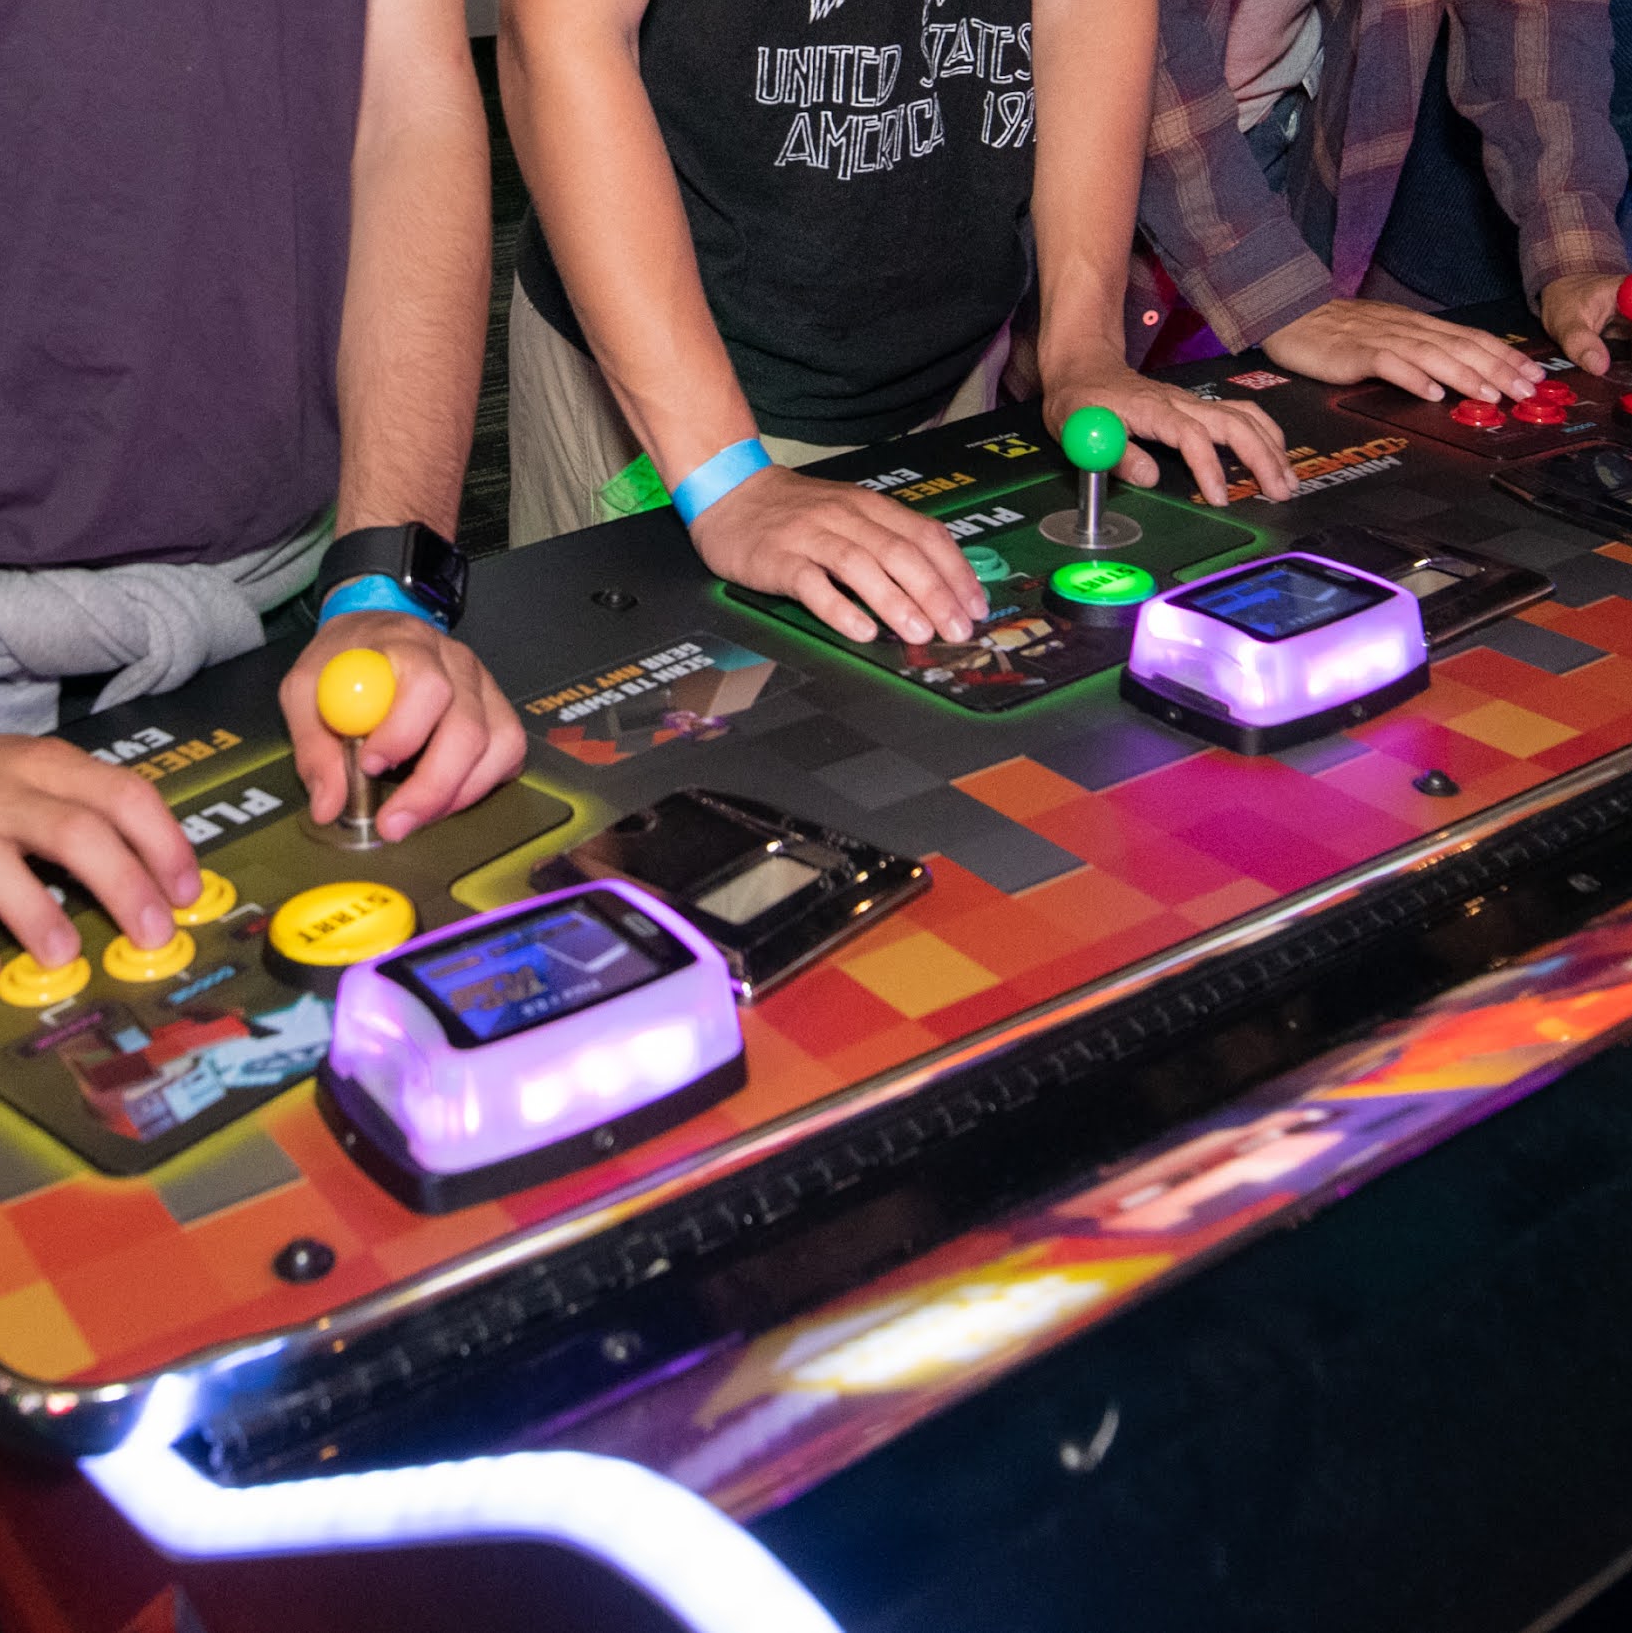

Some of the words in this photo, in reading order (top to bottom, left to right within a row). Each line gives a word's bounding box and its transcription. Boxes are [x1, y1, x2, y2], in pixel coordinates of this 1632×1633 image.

[756, 44, 902, 107] UNITED
[774, 91, 946, 180] AMERICA
[1072, 566, 1136, 594] START
[637, 641, 703, 672] GEAR
[650, 653, 716, 684] SCAN
[595, 664, 645, 689] ANY
[618, 677, 659, 696] TO
[524, 683, 598, 716] TIME!
[557, 688, 627, 723] SWAP
[298, 891, 391, 945] START
